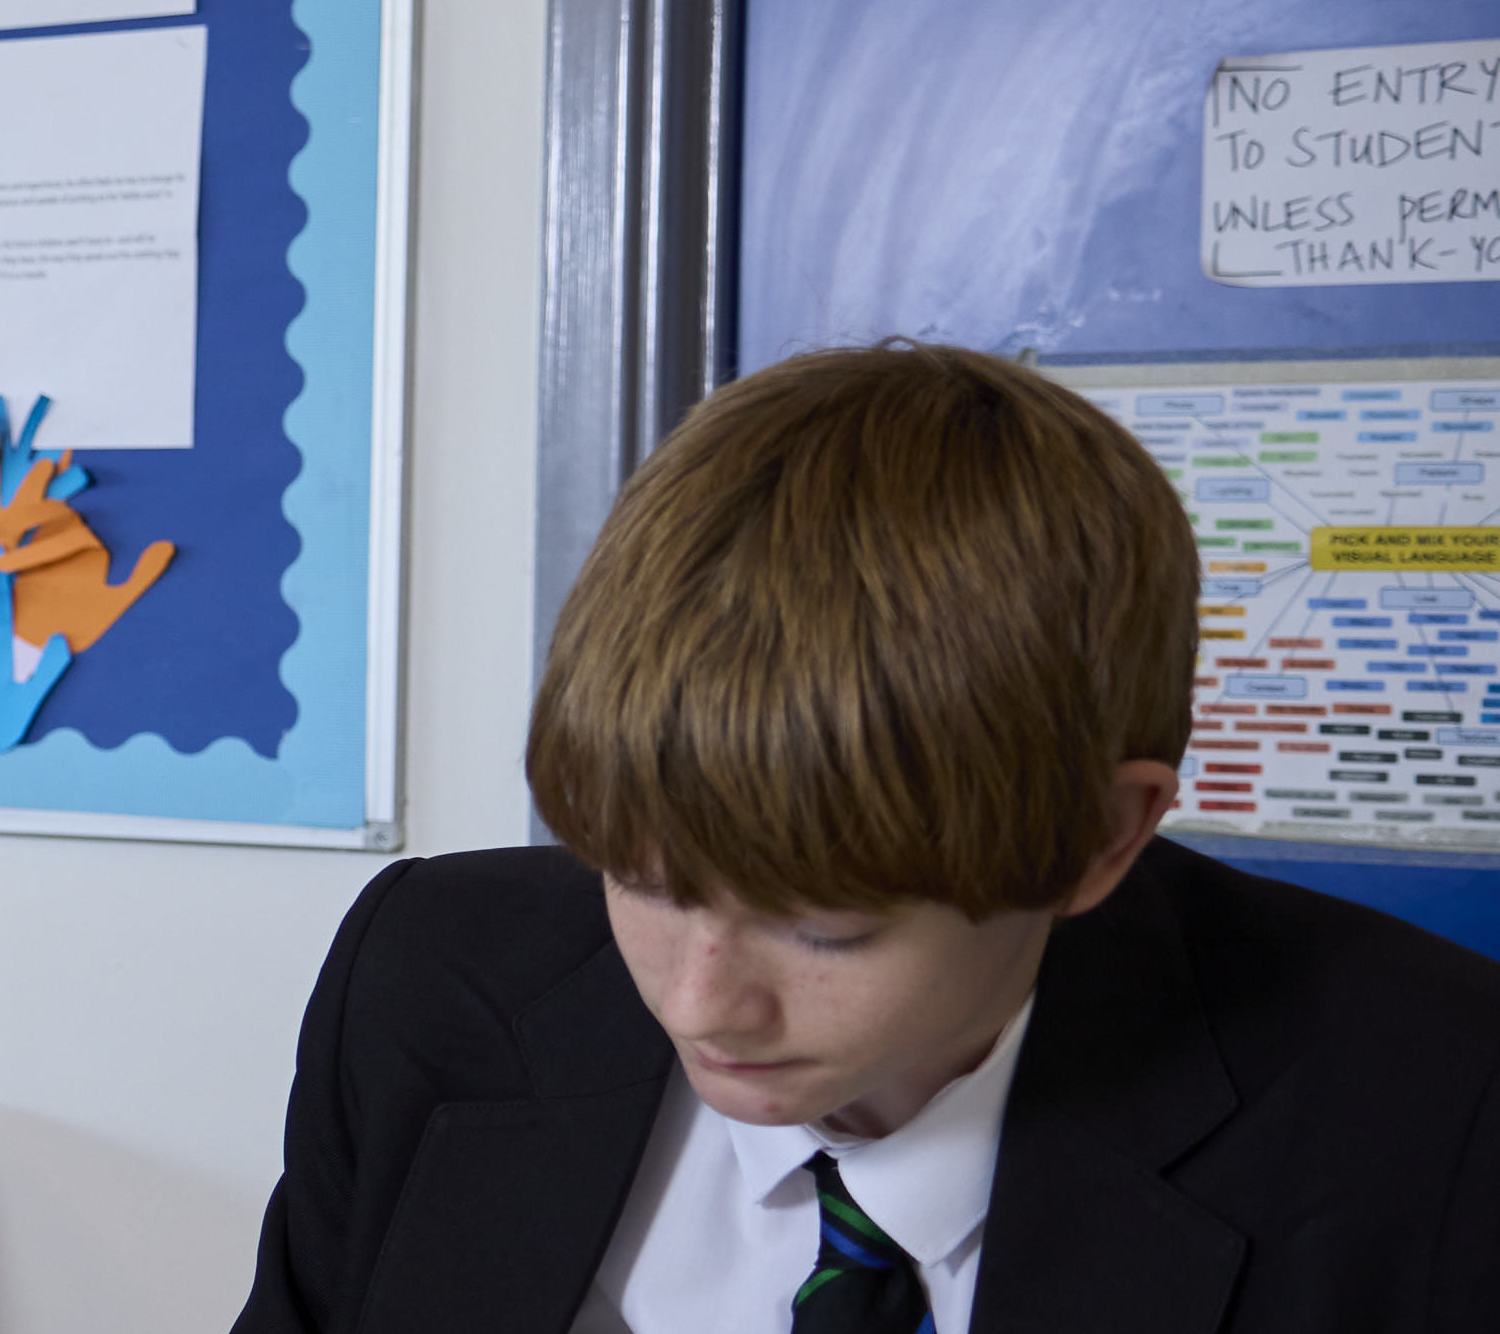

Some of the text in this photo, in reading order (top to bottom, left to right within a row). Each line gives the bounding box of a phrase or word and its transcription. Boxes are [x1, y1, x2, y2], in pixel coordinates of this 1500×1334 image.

[1229, 57, 1500, 113] NO ENTRY
[1285, 119, 1500, 168] STUDEN
[1213, 190, 1354, 233] UNLESS
[1332, 550, 1498, 563] VISUAL LANGUAGE
[1375, 533, 1411, 545] AND
